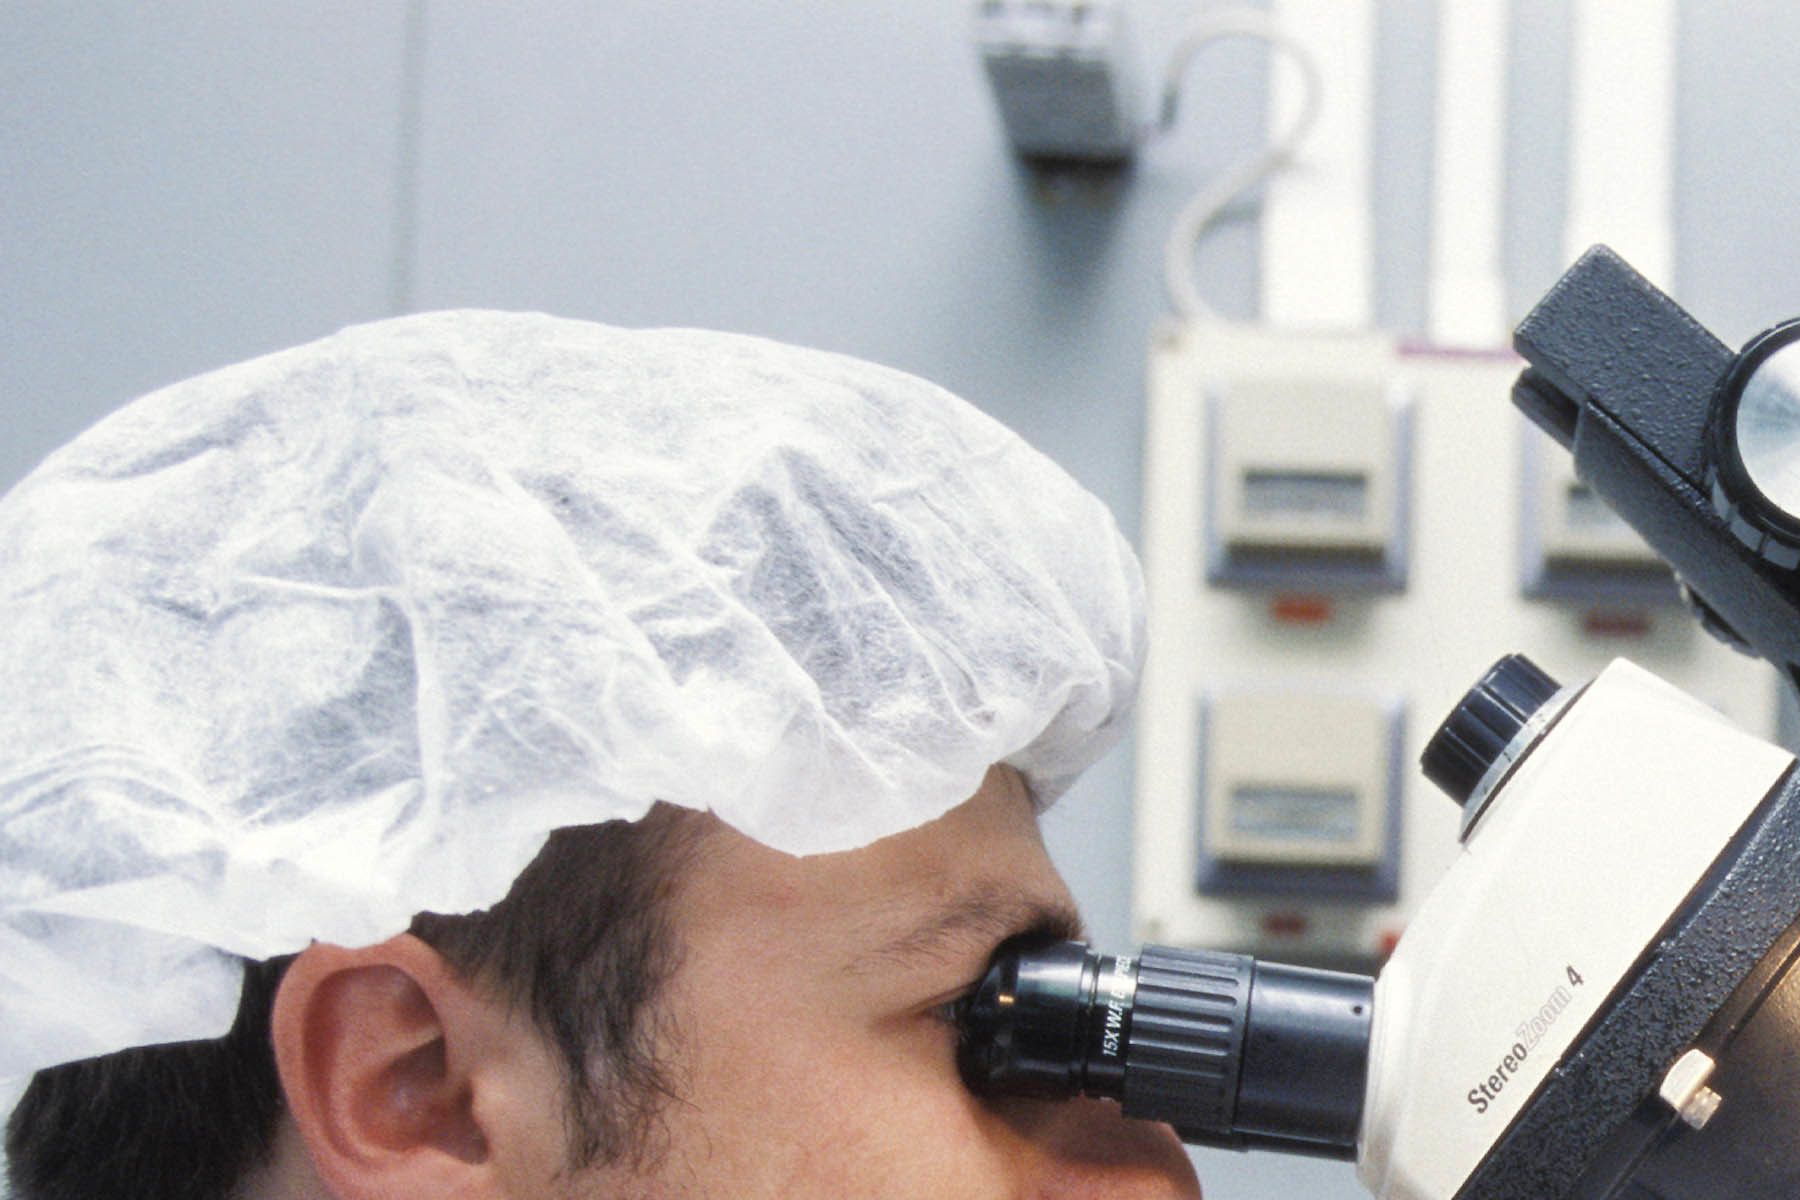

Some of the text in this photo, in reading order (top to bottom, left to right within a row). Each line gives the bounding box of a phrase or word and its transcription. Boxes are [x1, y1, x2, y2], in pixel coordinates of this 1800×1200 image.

[1102, 1029, 1120, 1057] 15X
[1467, 964, 1585, 1115] StereoZoom 4
